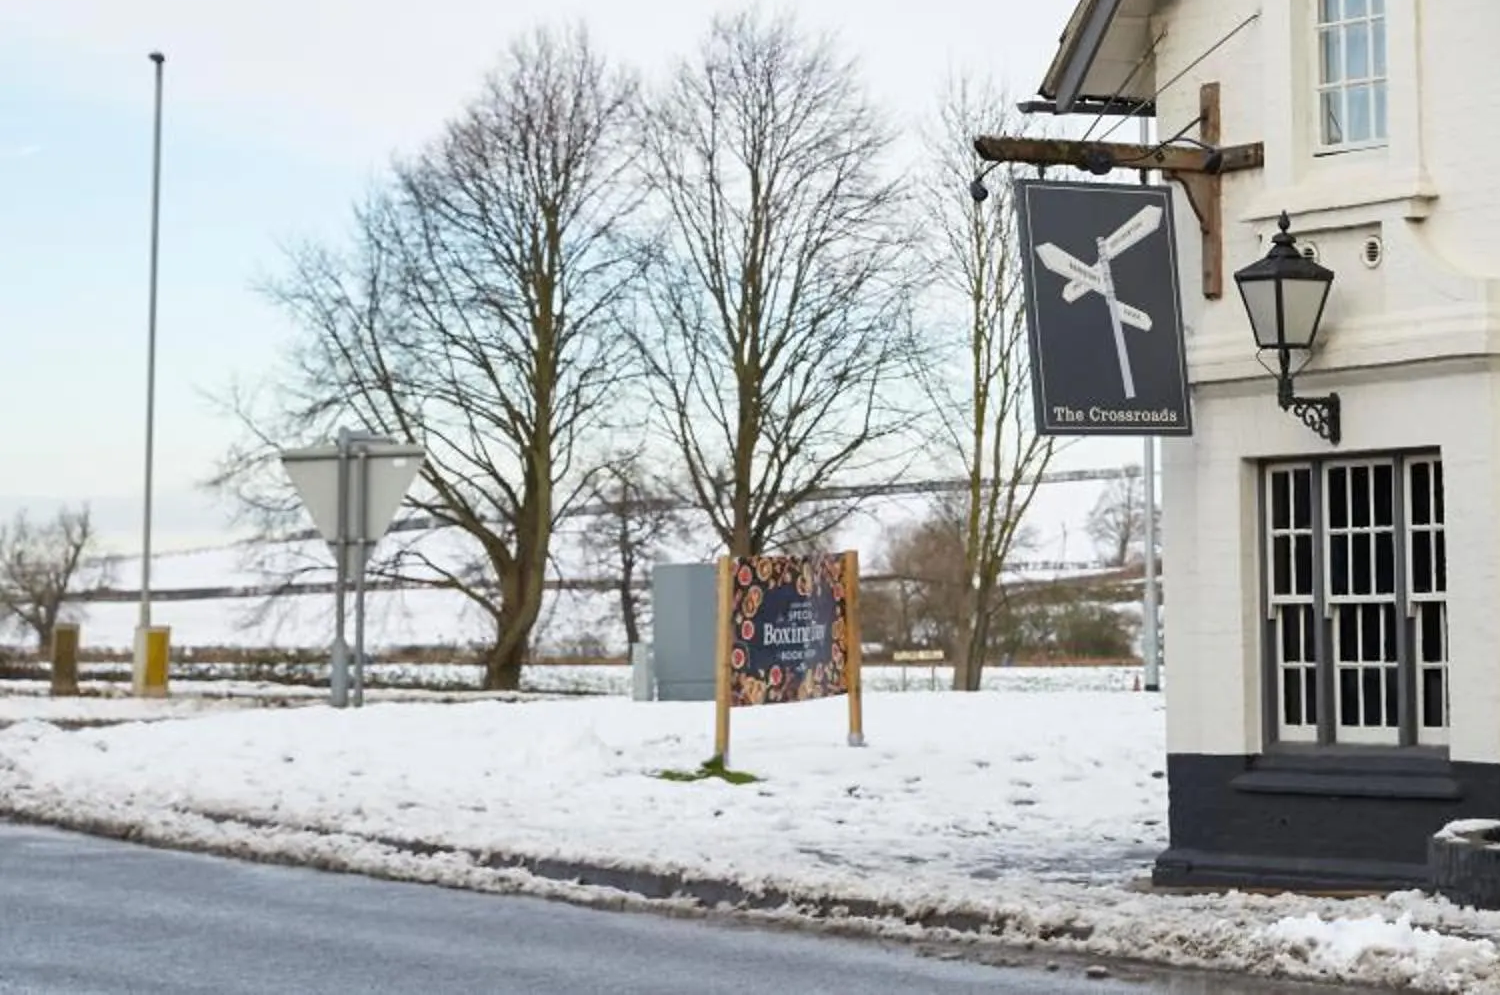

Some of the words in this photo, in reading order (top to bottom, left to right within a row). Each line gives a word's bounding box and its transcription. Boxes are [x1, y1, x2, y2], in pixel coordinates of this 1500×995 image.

[1053, 404, 1084, 422] The
[1089, 405, 1177, 422] Crossroads
[763, 622, 810, 649] Boxing
